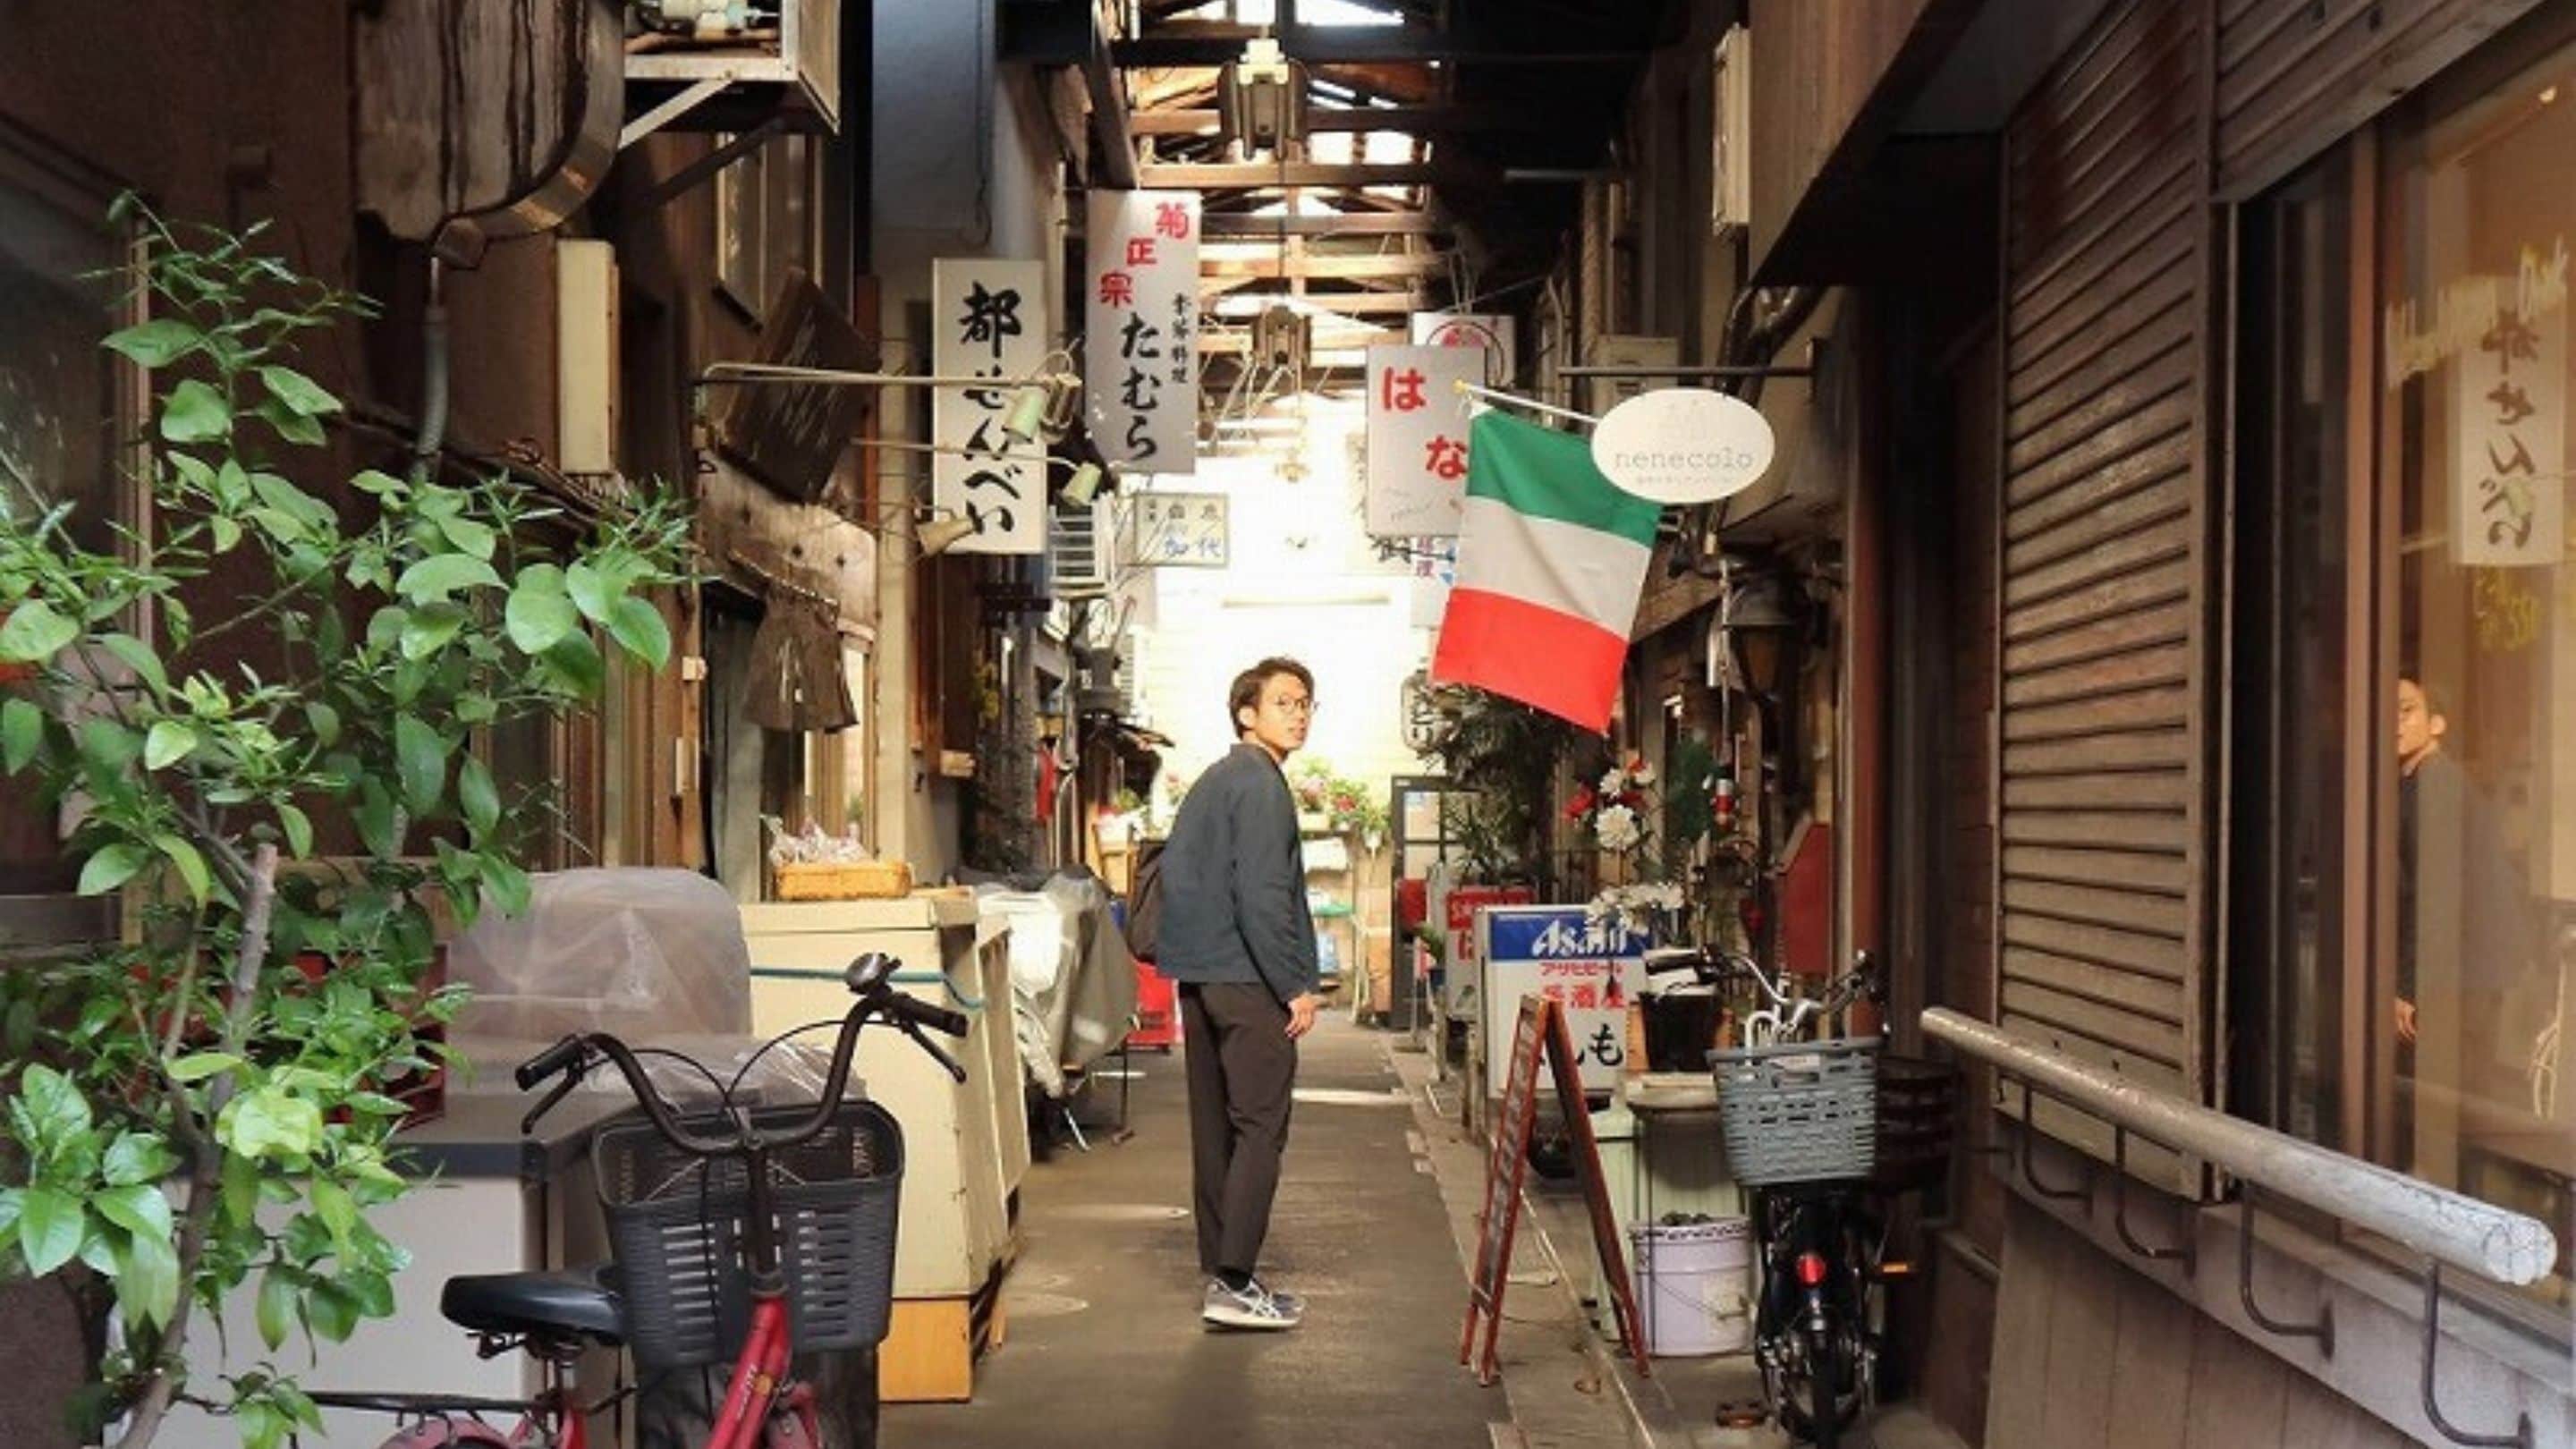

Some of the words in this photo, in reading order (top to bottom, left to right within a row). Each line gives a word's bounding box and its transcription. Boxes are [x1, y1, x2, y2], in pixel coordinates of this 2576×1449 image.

[1100, 202, 1191, 309] 菊正宗
[958, 280, 1023, 535] 都せんべい
[1120, 312, 1162, 462] たむら
[1614, 446, 1755, 470] nenecolo
